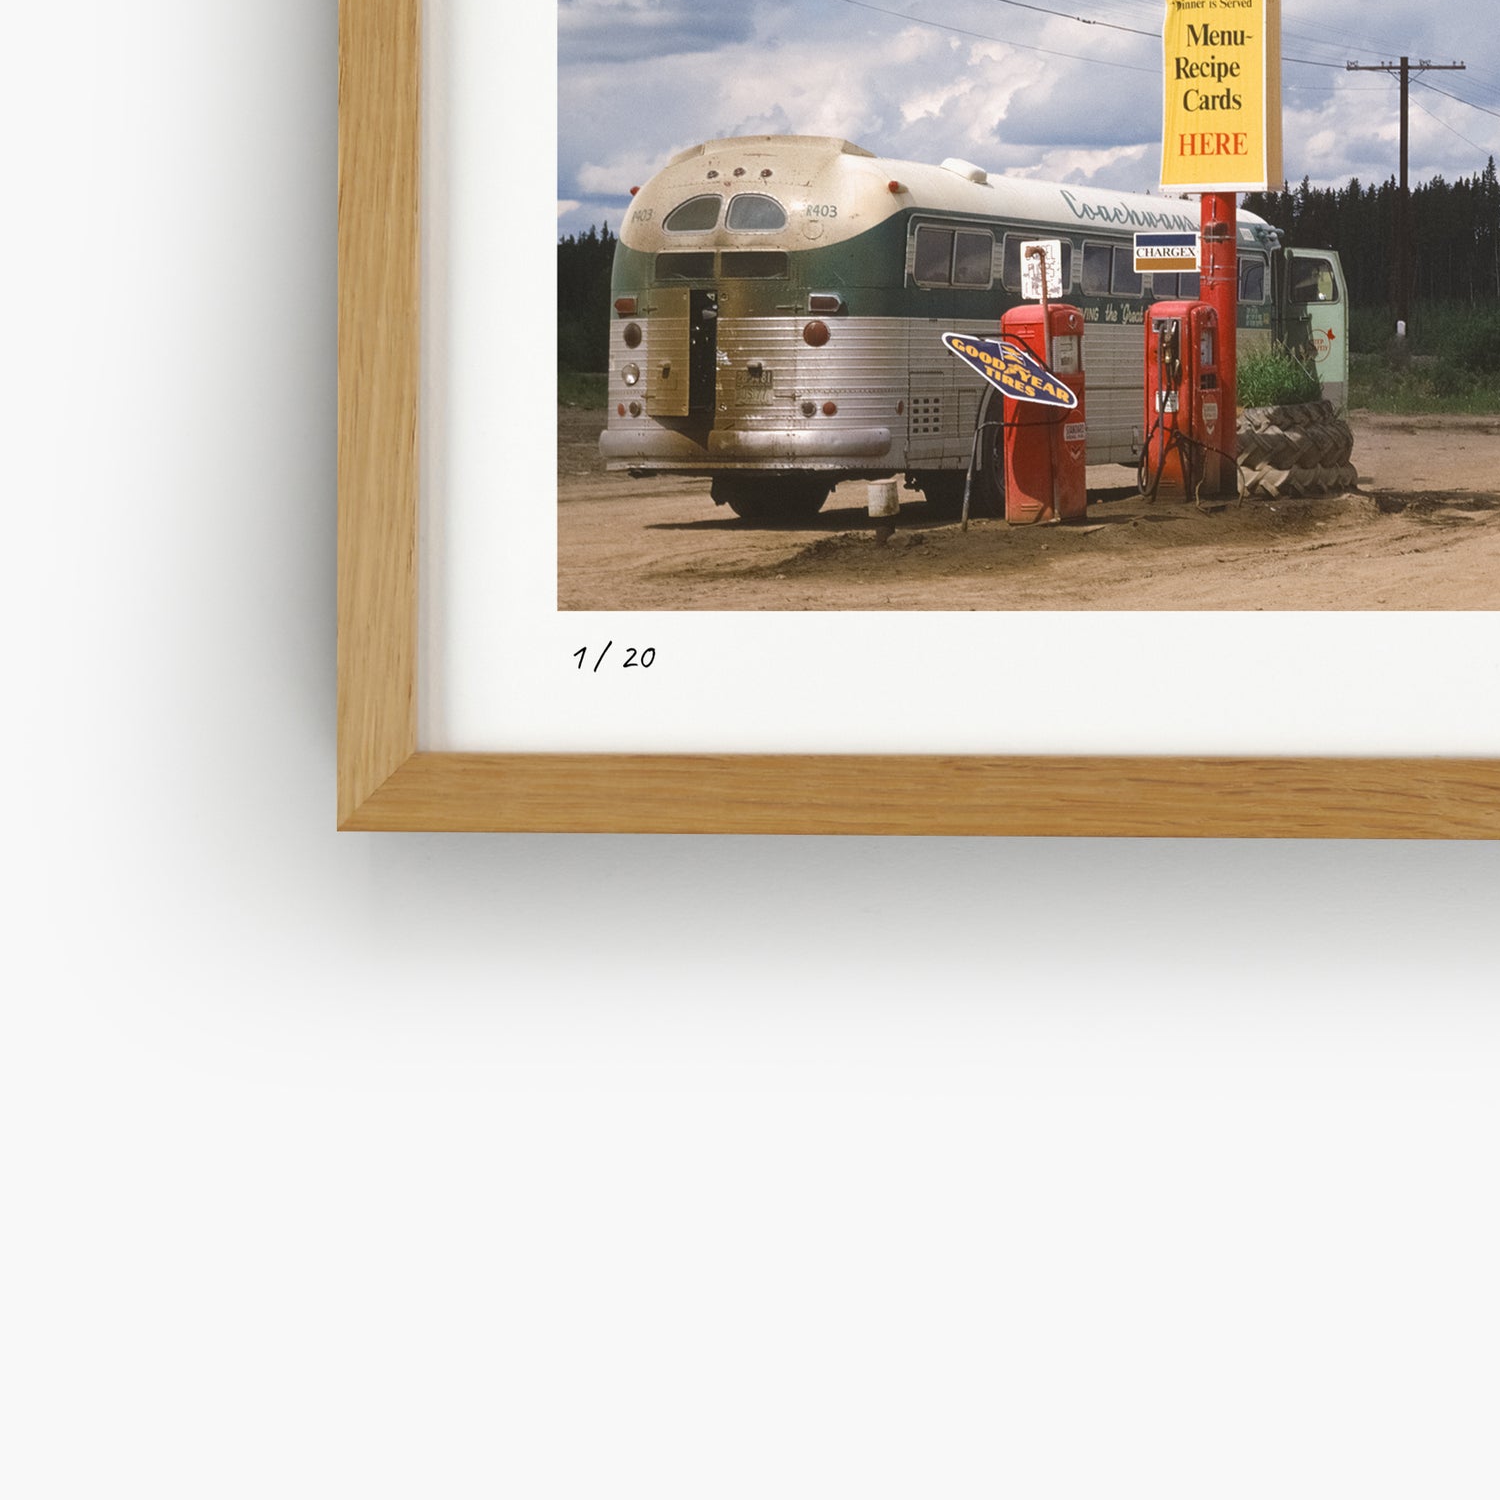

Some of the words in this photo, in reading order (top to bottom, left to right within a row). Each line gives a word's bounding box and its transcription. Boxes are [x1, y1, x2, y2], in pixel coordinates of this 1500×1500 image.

[1187, 23, 1253, 48] Menu-
[1175, 55, 1240, 83] Recipe
[1183, 87, 1242, 112] Cards
[1178, 132, 1248, 157] HERE
[1136, 247, 1196, 259] CHARGEX
[1105, 303, 1118, 322] the
[951, 338, 1070, 404] GOODYEAR
[984, 365, 1036, 397] TIRES
